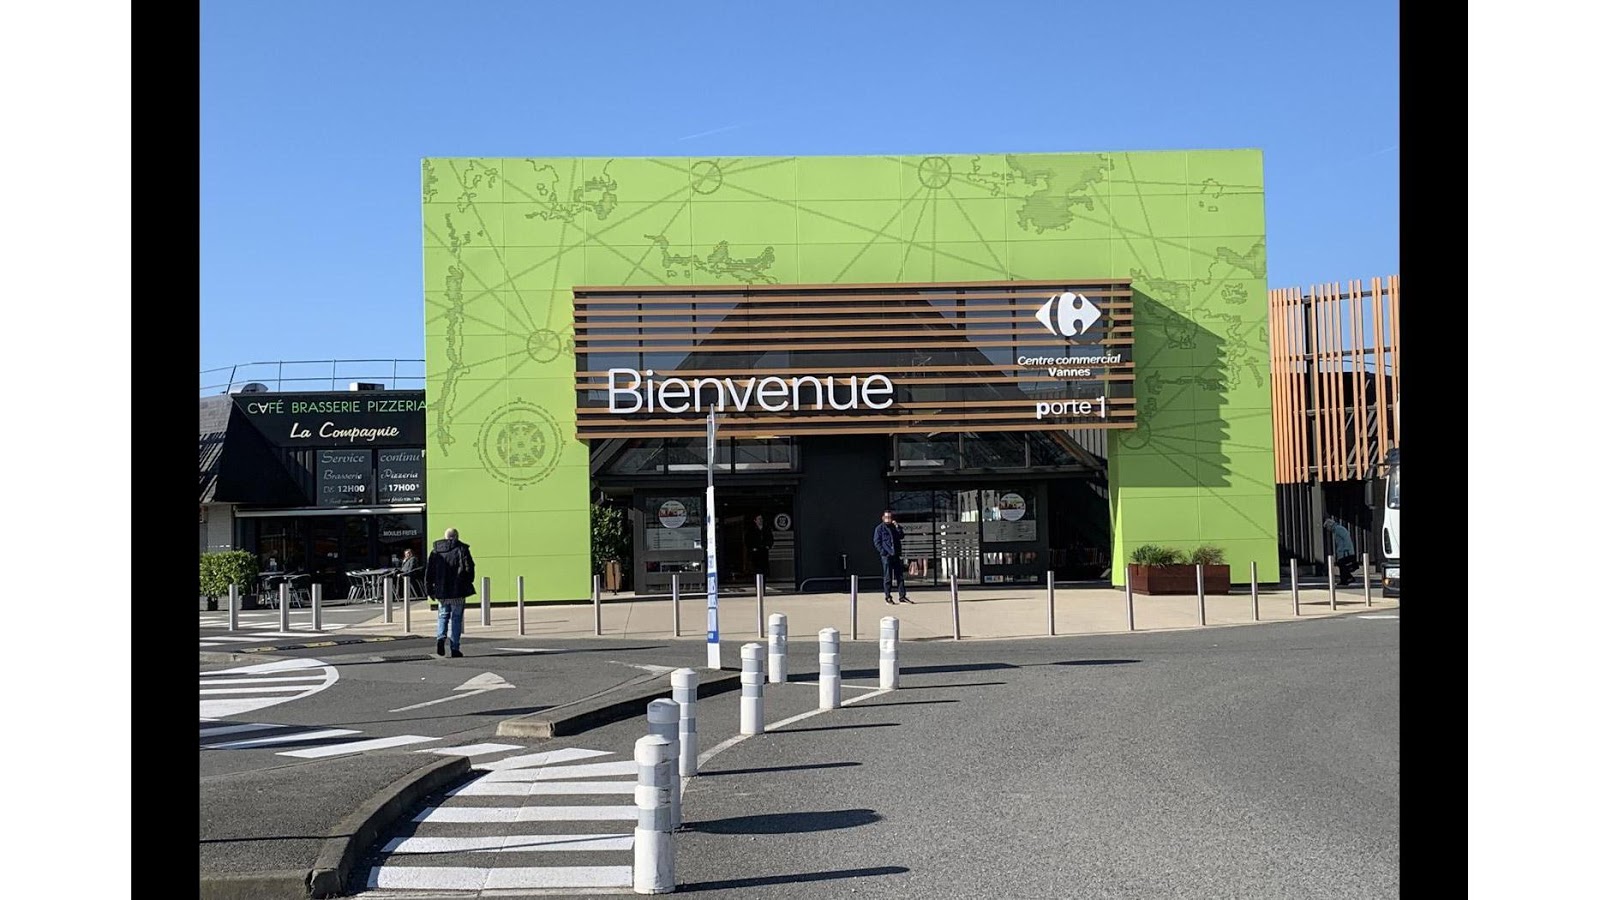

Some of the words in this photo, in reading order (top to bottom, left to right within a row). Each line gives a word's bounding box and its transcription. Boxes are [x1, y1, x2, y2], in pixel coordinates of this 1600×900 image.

[1017, 355, 1055, 366] Centre
[1055, 354, 1121, 365] commercial
[1048, 367, 1091, 377] Vannes
[608, 368, 894, 414] Bienvenue
[291, 401, 360, 413] BRASSERIE
[368, 400, 427, 412] PIZZERIA
[1036, 399, 1092, 420] porte
[1095, 395, 1106, 418] 1
[290, 422, 312, 438] La
[319, 421, 400, 442] Compagnie
[321, 450, 365, 463] Service
[380, 452, 420, 462] continu
[323, 469, 363, 480] Brasserie
[380, 468, 418, 479] Pizzeria
[338, 484, 365, 492] 12H00
